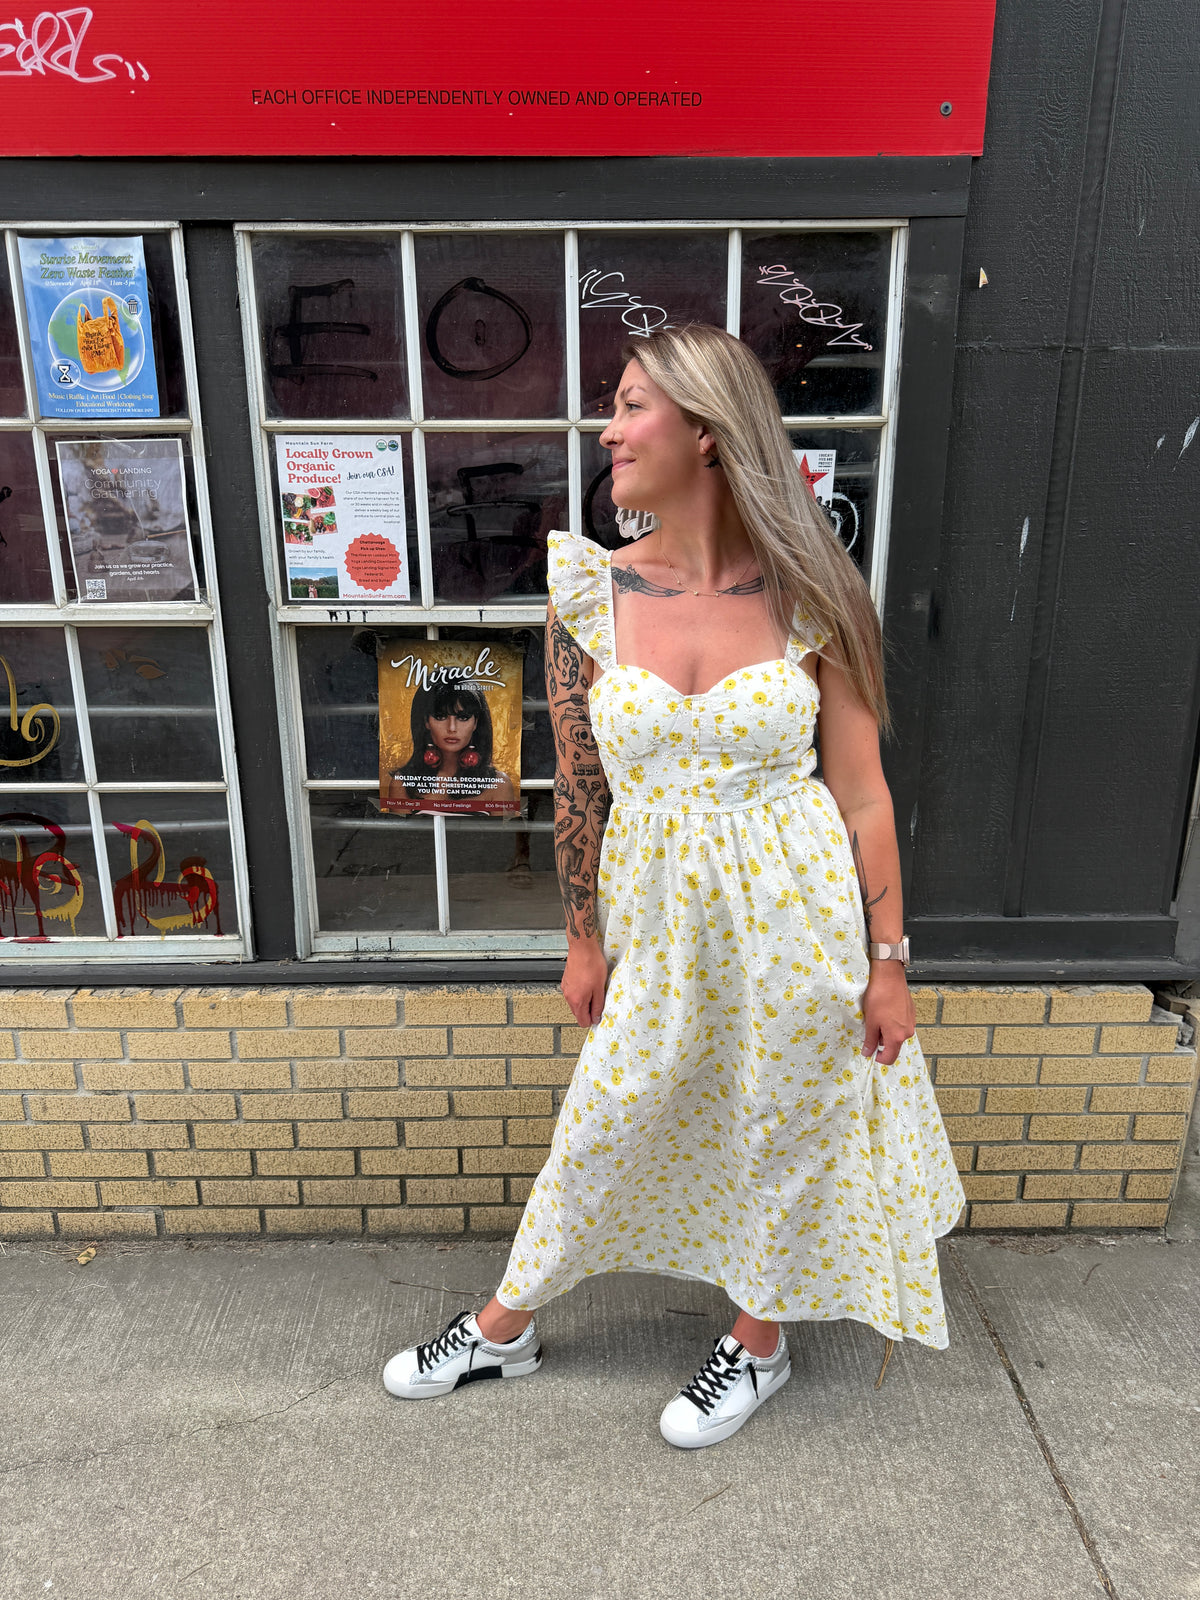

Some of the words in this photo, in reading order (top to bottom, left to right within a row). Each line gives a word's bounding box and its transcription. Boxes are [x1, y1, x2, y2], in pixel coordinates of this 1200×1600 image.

[252, 89, 297, 105] EACH
[302, 89, 362, 105] OFFICE
[367, 89, 504, 105] INDEPENDENTLY
[508, 90, 571, 106] OWNED
[575, 90, 609, 106] AND
[614, 91, 702, 107] OPERATED
[40, 253, 77, 265] Sunrise
[79, 252, 134, 265] Movement
[41, 267, 65, 280] Zero
[67, 266, 96, 279] Waste
[98, 266, 136, 279] Festival
[48, 392, 67, 401] Music
[102, 393, 115, 401] Food
[286, 448, 329, 460] Locally
[332, 448, 374, 459] Grown
[119, 467, 152, 475] LANDING
[286, 460, 336, 473] Organic
[288, 473, 342, 484] Produce!
[347, 471, 361, 481] Join
[85, 478, 161, 490] Community
[91, 488, 158, 501] Gathering
[343, 592, 406, 600] MountainSunFarm.com
[390, 647, 502, 692] Miracle
[453, 684, 461, 692] ON
[461, 684, 477, 692] BROAD
[477, 684, 494, 692] STREET
[422, 775, 460, 783] COCKTAILS,
[460, 776, 506, 784] DECORATIONS,
[452, 802, 472, 810] Feelings
